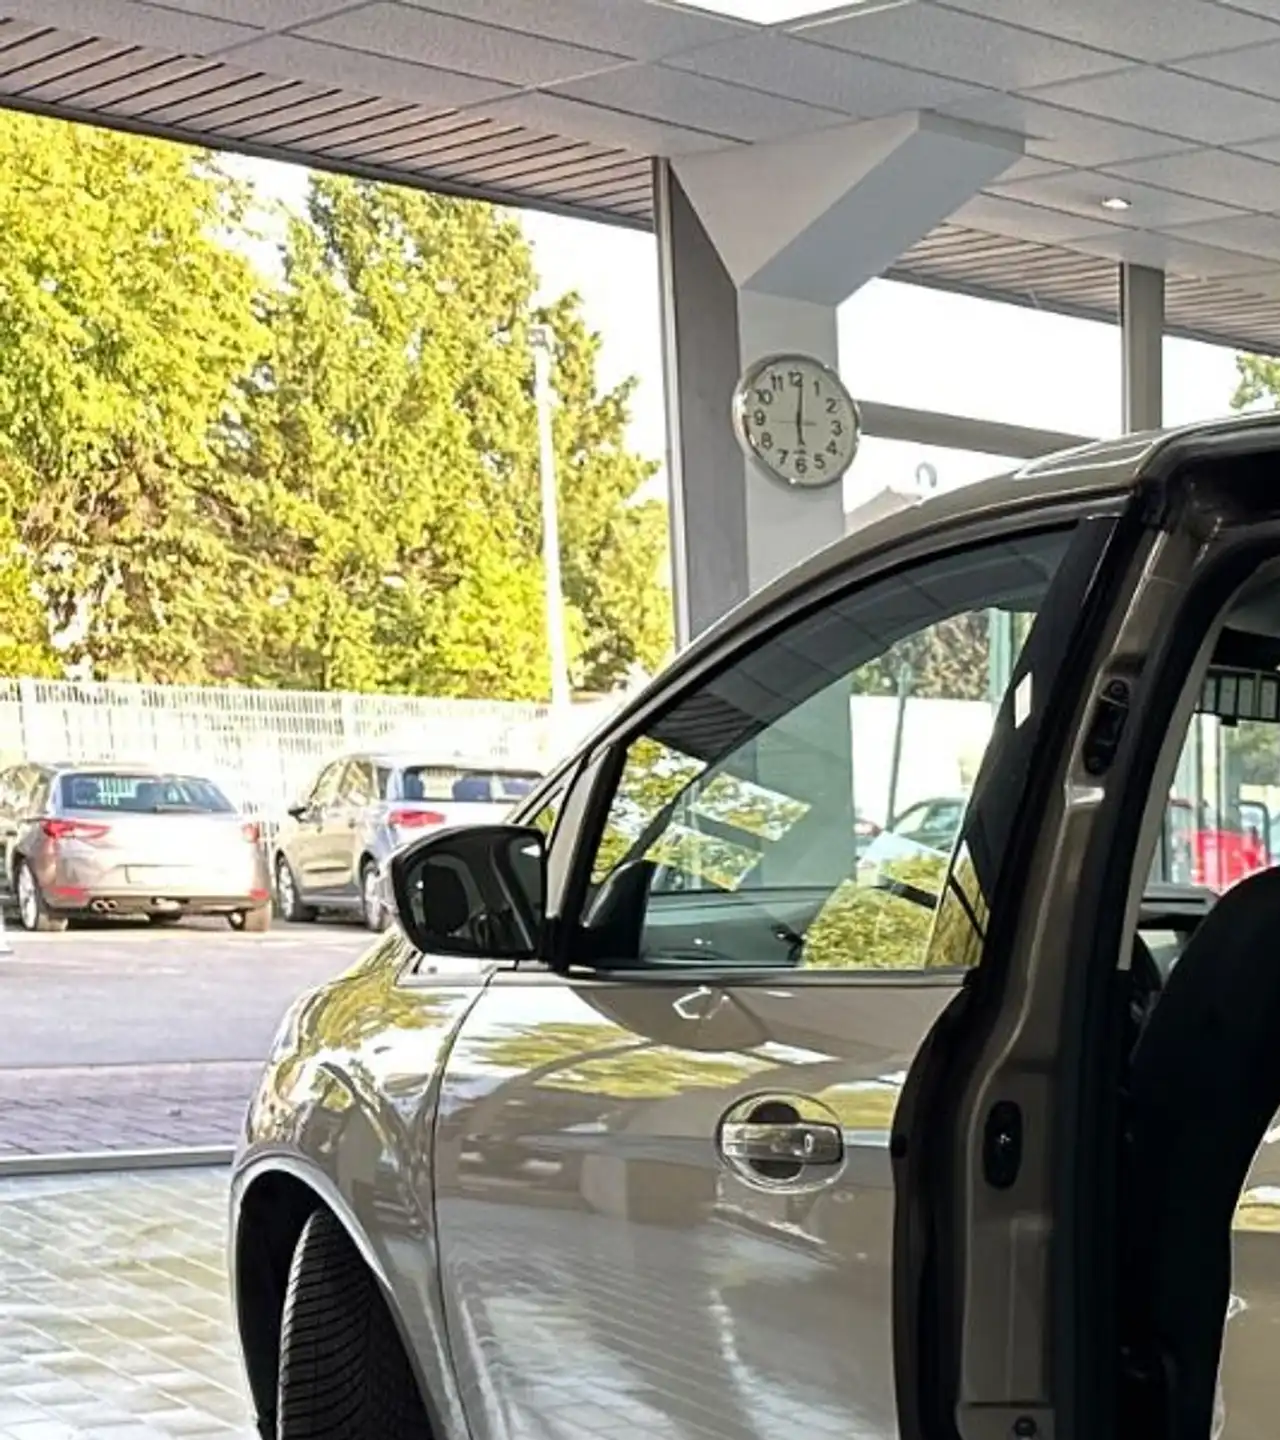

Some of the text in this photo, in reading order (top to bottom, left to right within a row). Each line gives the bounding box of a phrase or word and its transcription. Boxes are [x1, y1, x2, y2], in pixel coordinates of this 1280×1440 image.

[771, 374, 783, 391] 11
[788, 370, 804, 387] 12
[813, 381, 821, 396] 1
[756, 389, 773, 405] 10
[826, 398, 838, 414] 2
[753, 410, 766, 426] 9
[830, 420, 843, 436] 3
[760, 432, 773, 449] 8
[826, 440, 838, 456] 4
[777, 449, 789, 466] 7
[813, 454, 826, 470] 5
[795, 458, 808, 474] 6
